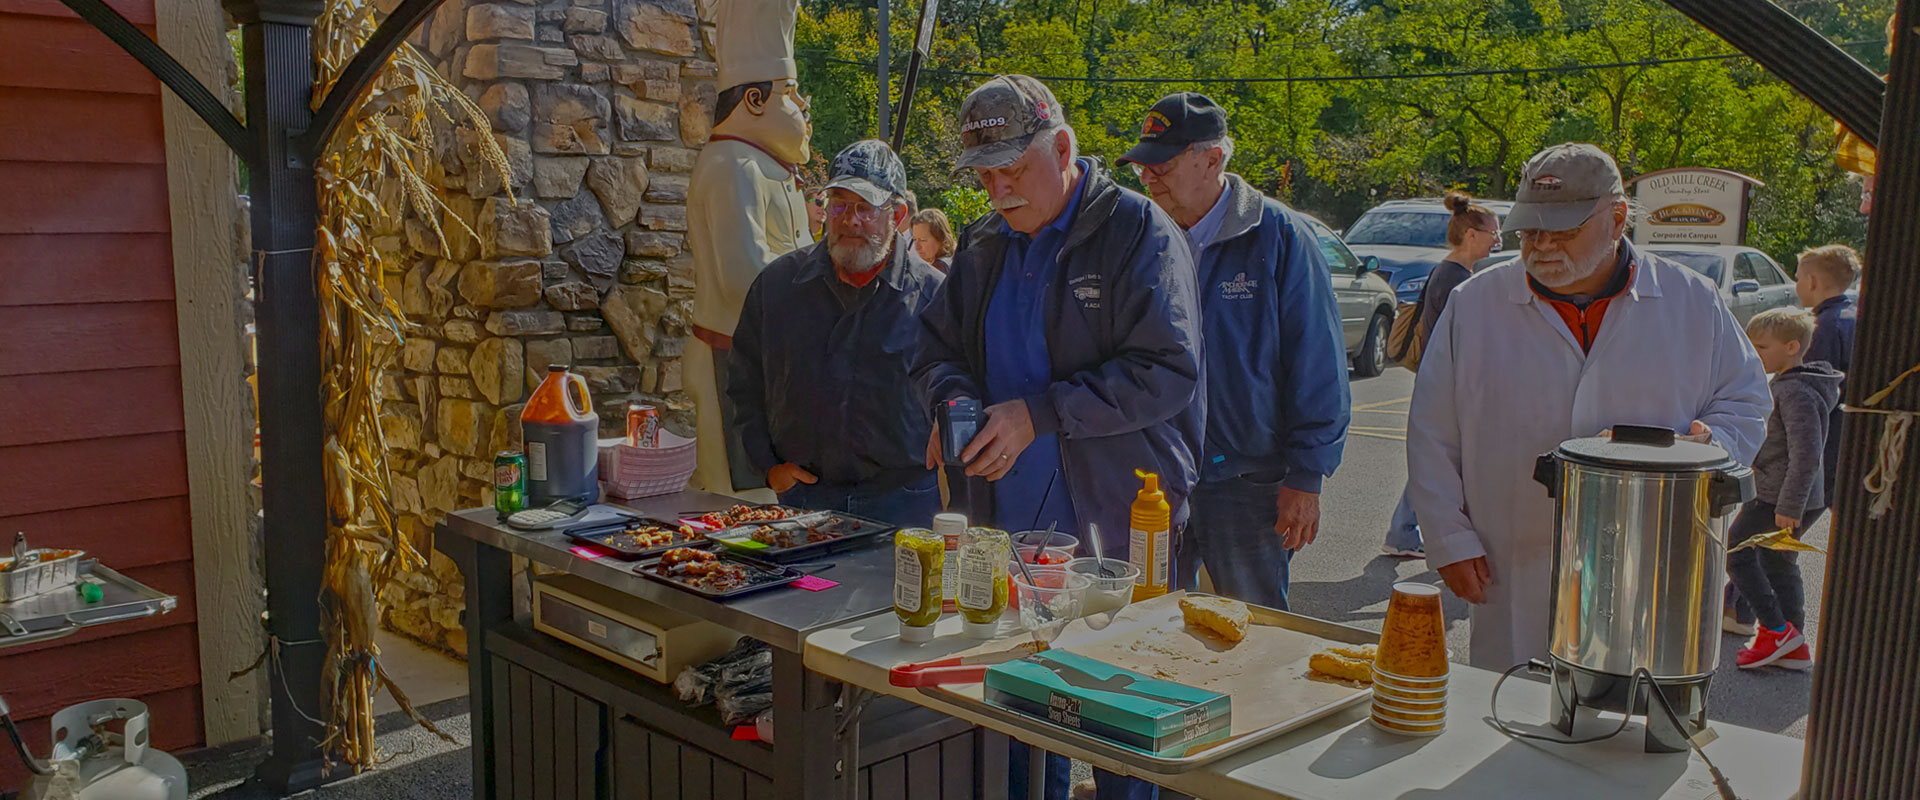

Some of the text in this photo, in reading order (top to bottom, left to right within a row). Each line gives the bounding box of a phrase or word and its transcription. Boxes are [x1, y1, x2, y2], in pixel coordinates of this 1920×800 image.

[1649, 174, 1729, 192] OLD MILL CREEK
[1664, 186, 1710, 196] Country Store
[1652, 231, 1717, 240] Corporate Campus
[1048, 706, 1081, 728] Snap Sheets
[1183, 728, 1194, 742] Snap
